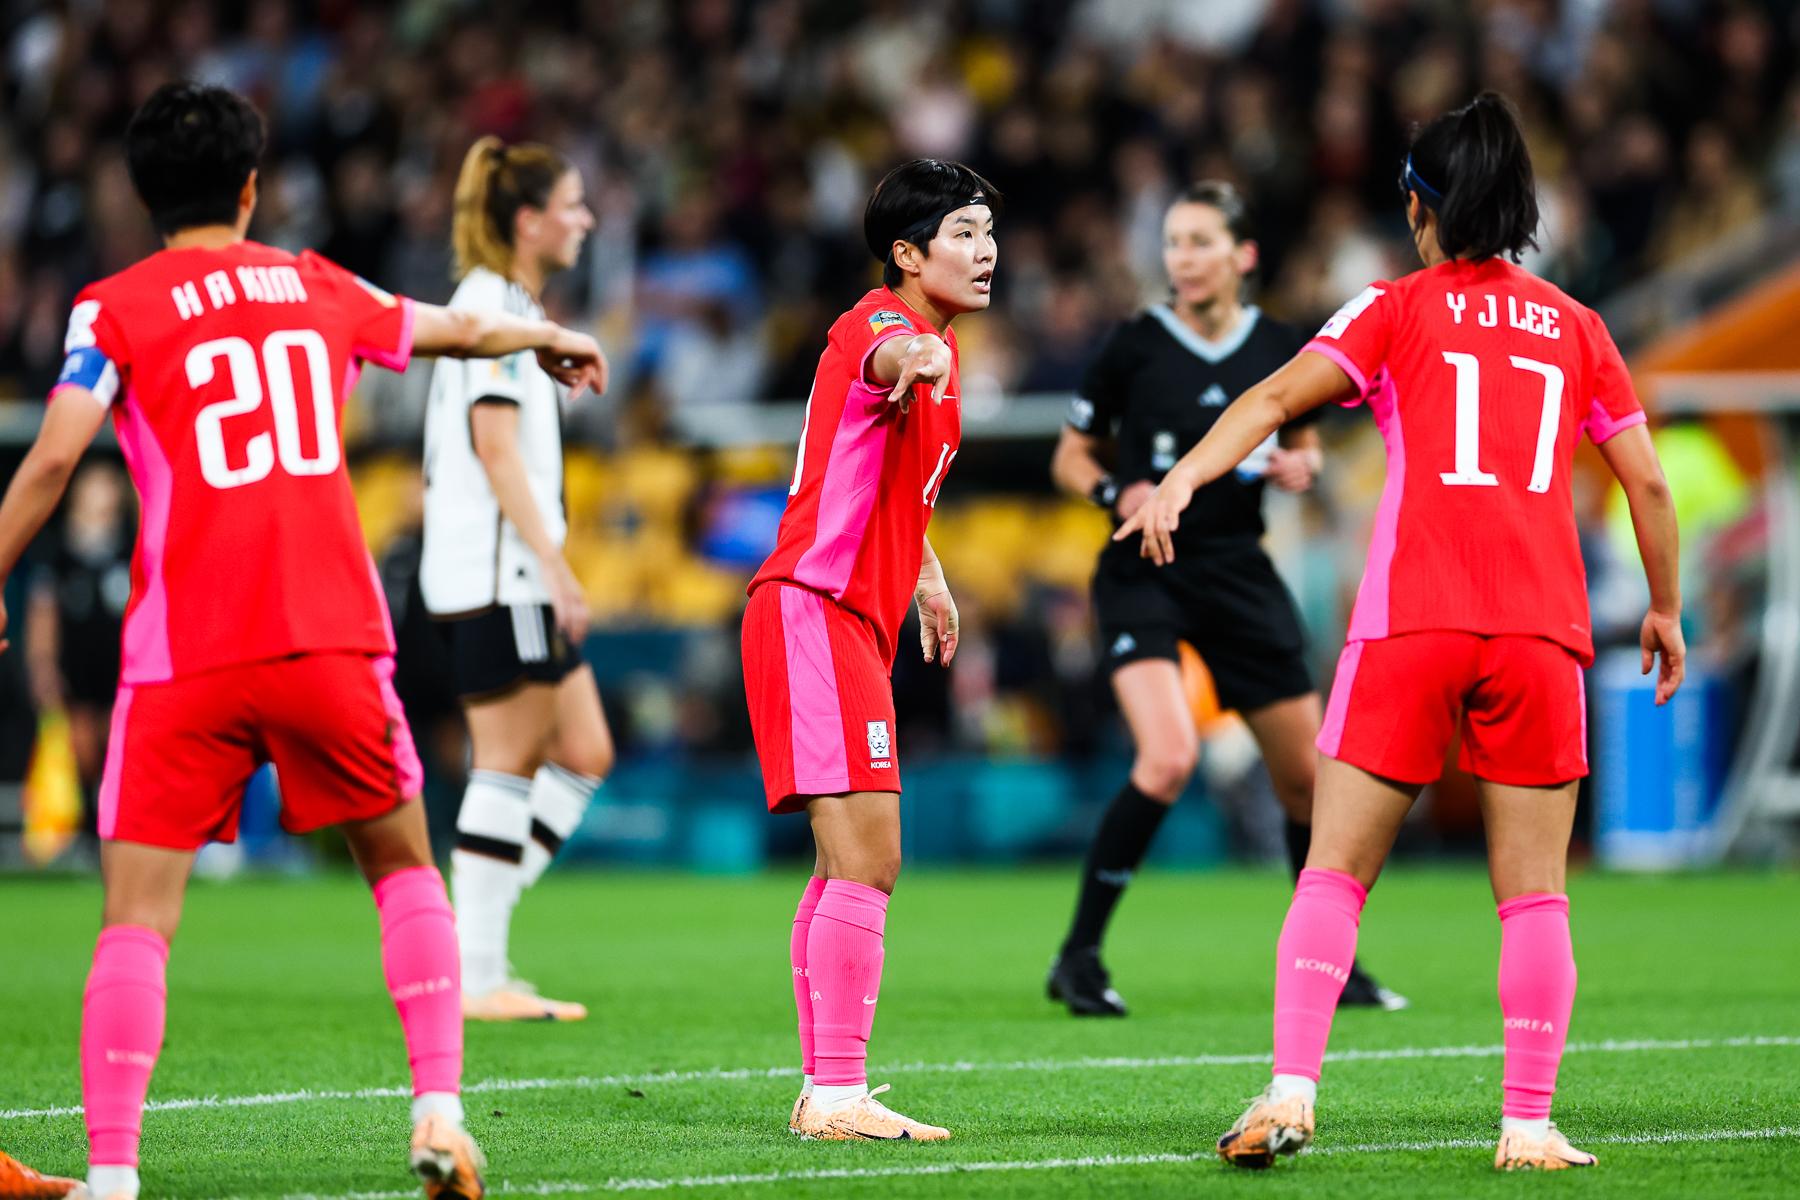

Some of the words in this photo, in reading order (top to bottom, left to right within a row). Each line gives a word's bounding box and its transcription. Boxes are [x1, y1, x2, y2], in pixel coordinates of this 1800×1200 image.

[171, 280, 204, 321] H
[203, 269, 236, 310] A
[235, 264, 308, 304] KIM
[1446, 291, 1467, 324] Y
[1478, 293, 1498, 328] J
[1507, 295, 1561, 340] LEE
[184, 328, 341, 490] 20
[1439, 351, 1565, 494] 17
[870, 761, 892, 769] KOREA
[1503, 1017, 1554, 1034] OREA
